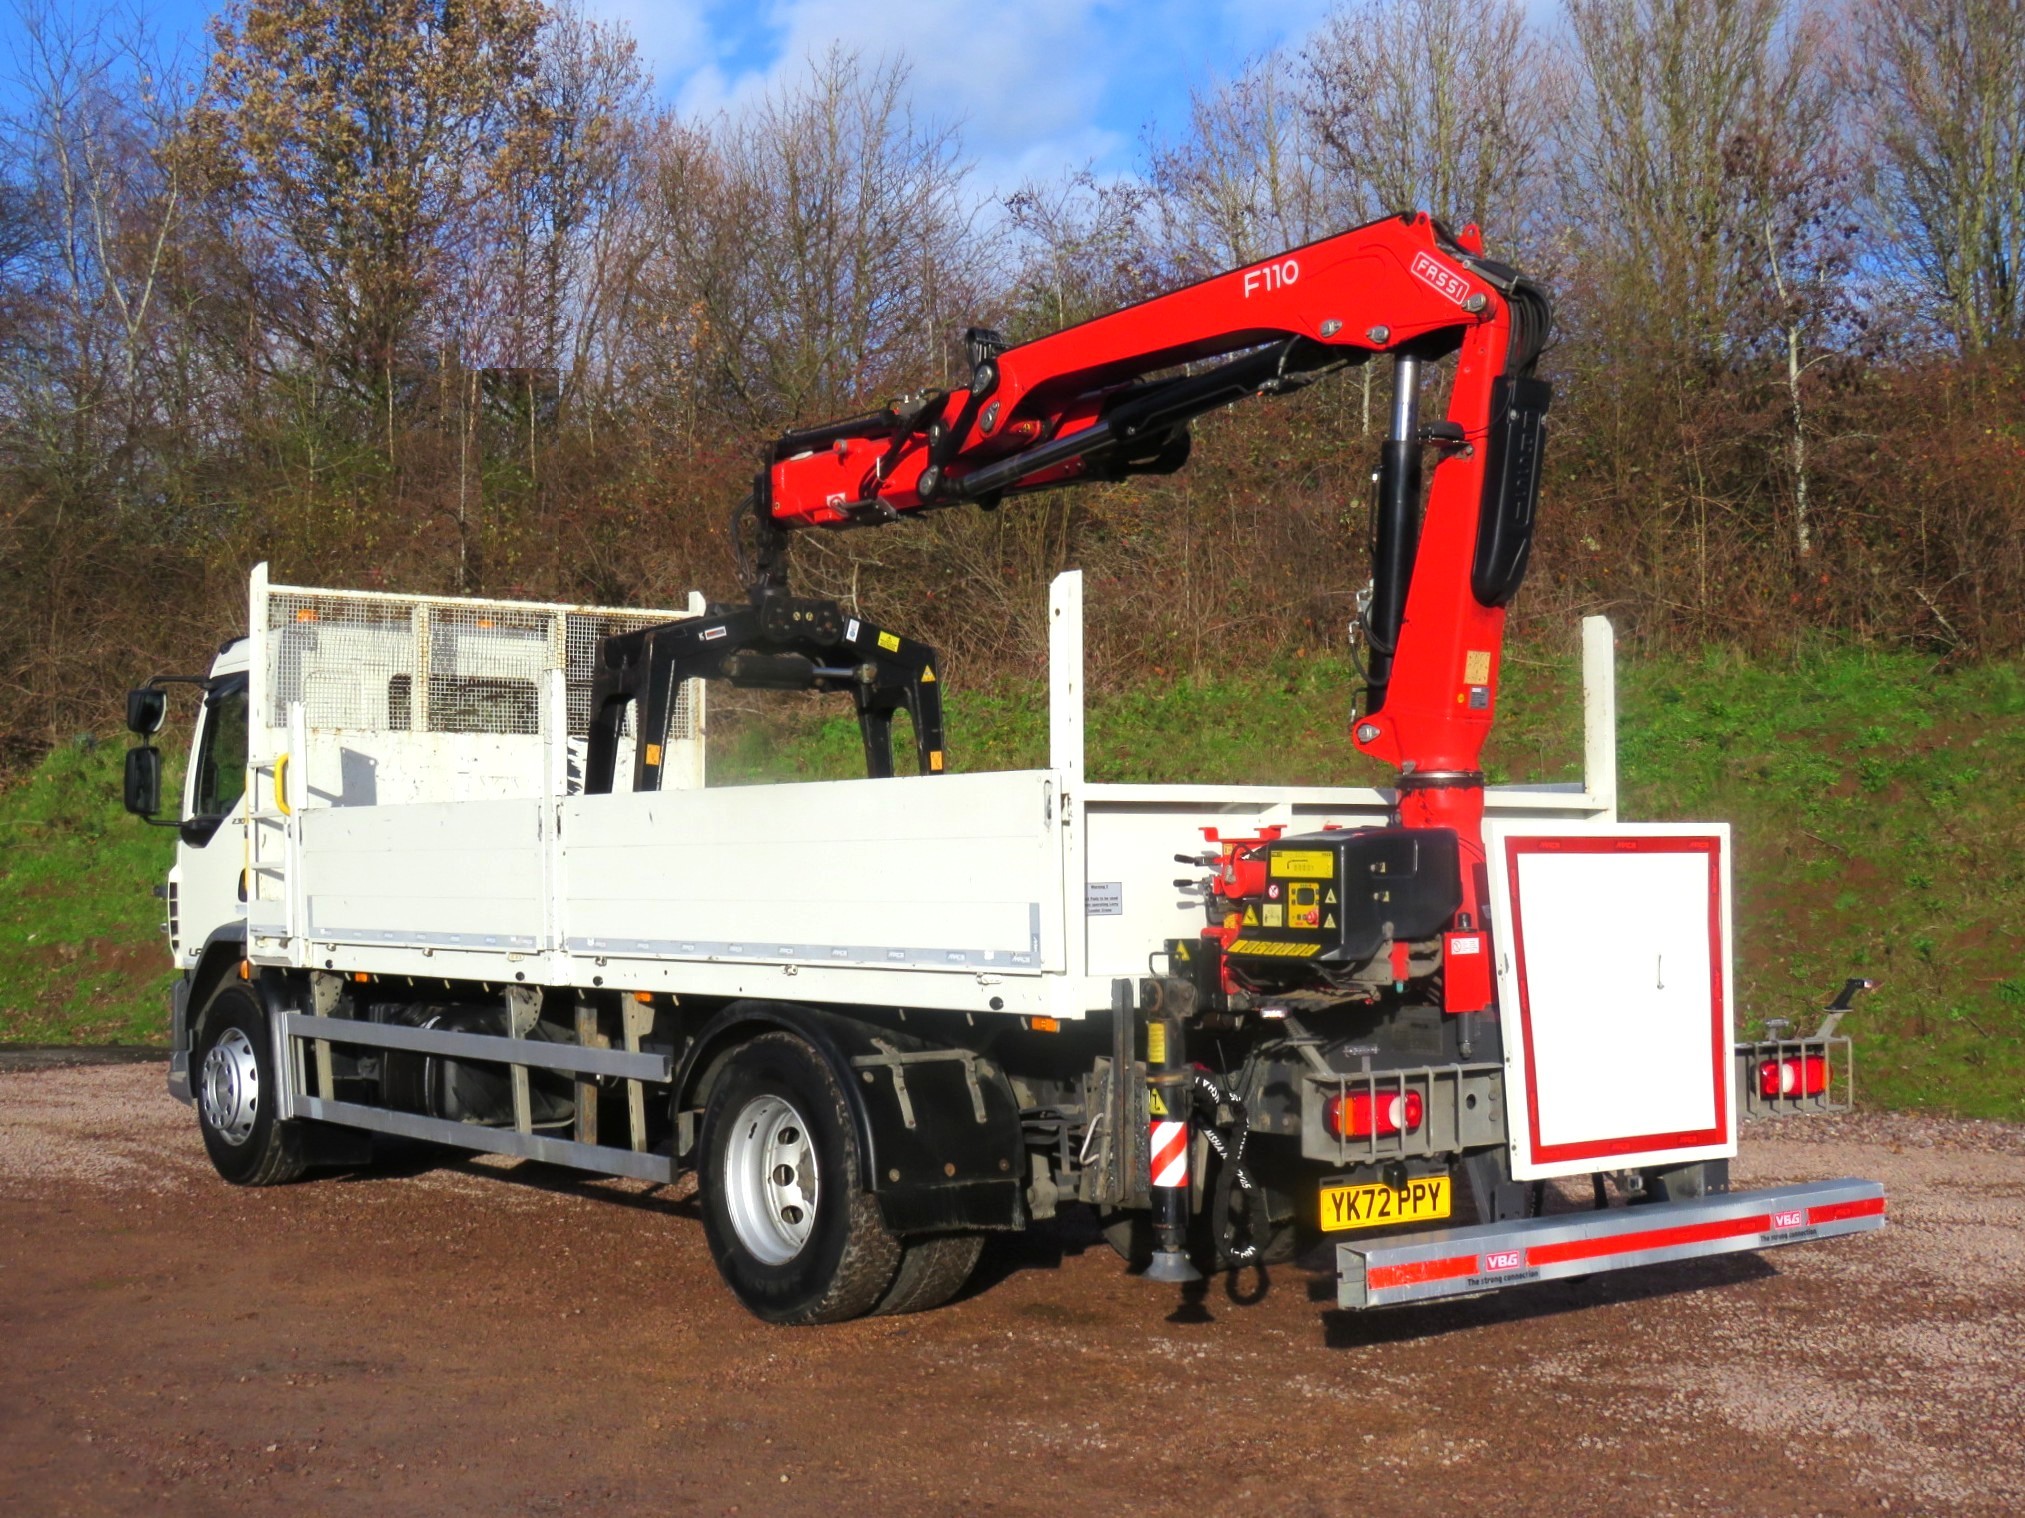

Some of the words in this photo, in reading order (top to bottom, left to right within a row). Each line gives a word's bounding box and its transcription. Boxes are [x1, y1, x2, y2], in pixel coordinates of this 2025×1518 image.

[1244, 259, 1299, 299] F110
[1417, 259, 1464, 299] FASSI
[1331, 1187, 1391, 1222] YK72
[1398, 1182, 1440, 1215] PPY
[1775, 1213, 1800, 1227] VBG
[1487, 1253, 1518, 1269] VBG
[1467, 1278, 1480, 1286] The
[1480, 1276, 1502, 1284] strong
[1503, 1270, 1539, 1280] connection
